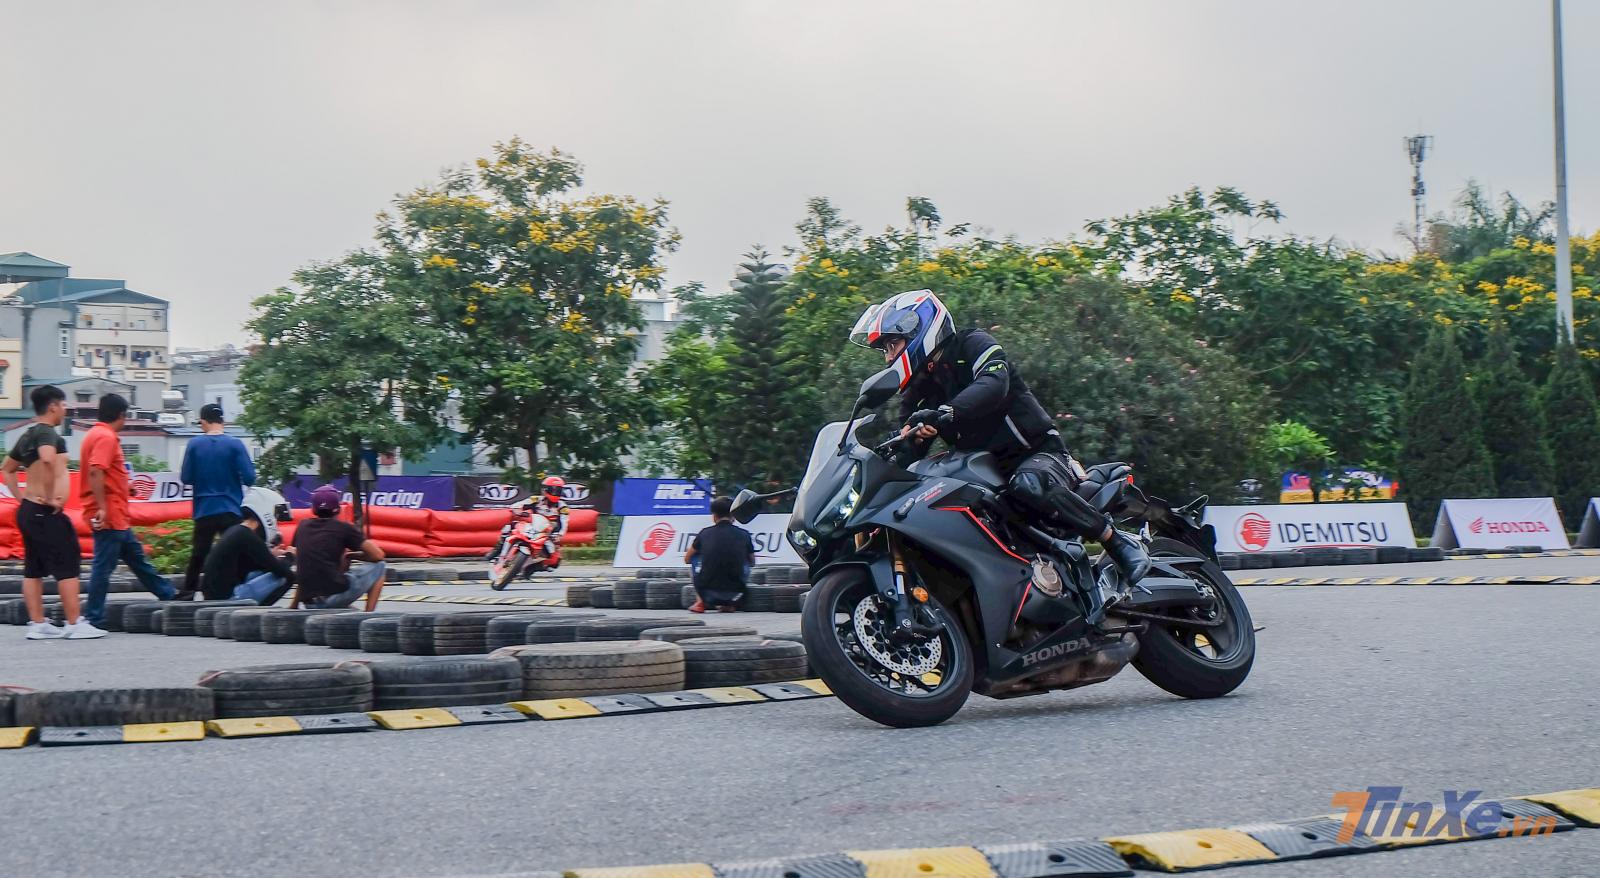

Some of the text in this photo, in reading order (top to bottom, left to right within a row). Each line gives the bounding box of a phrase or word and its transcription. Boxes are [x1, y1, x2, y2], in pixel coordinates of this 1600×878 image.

[368, 489, 425, 509] racing
[1277, 522, 1389, 544] IDEMITSU
[1486, 521, 1551, 534] HONDA
[1022, 637, 1091, 668] HONDA
